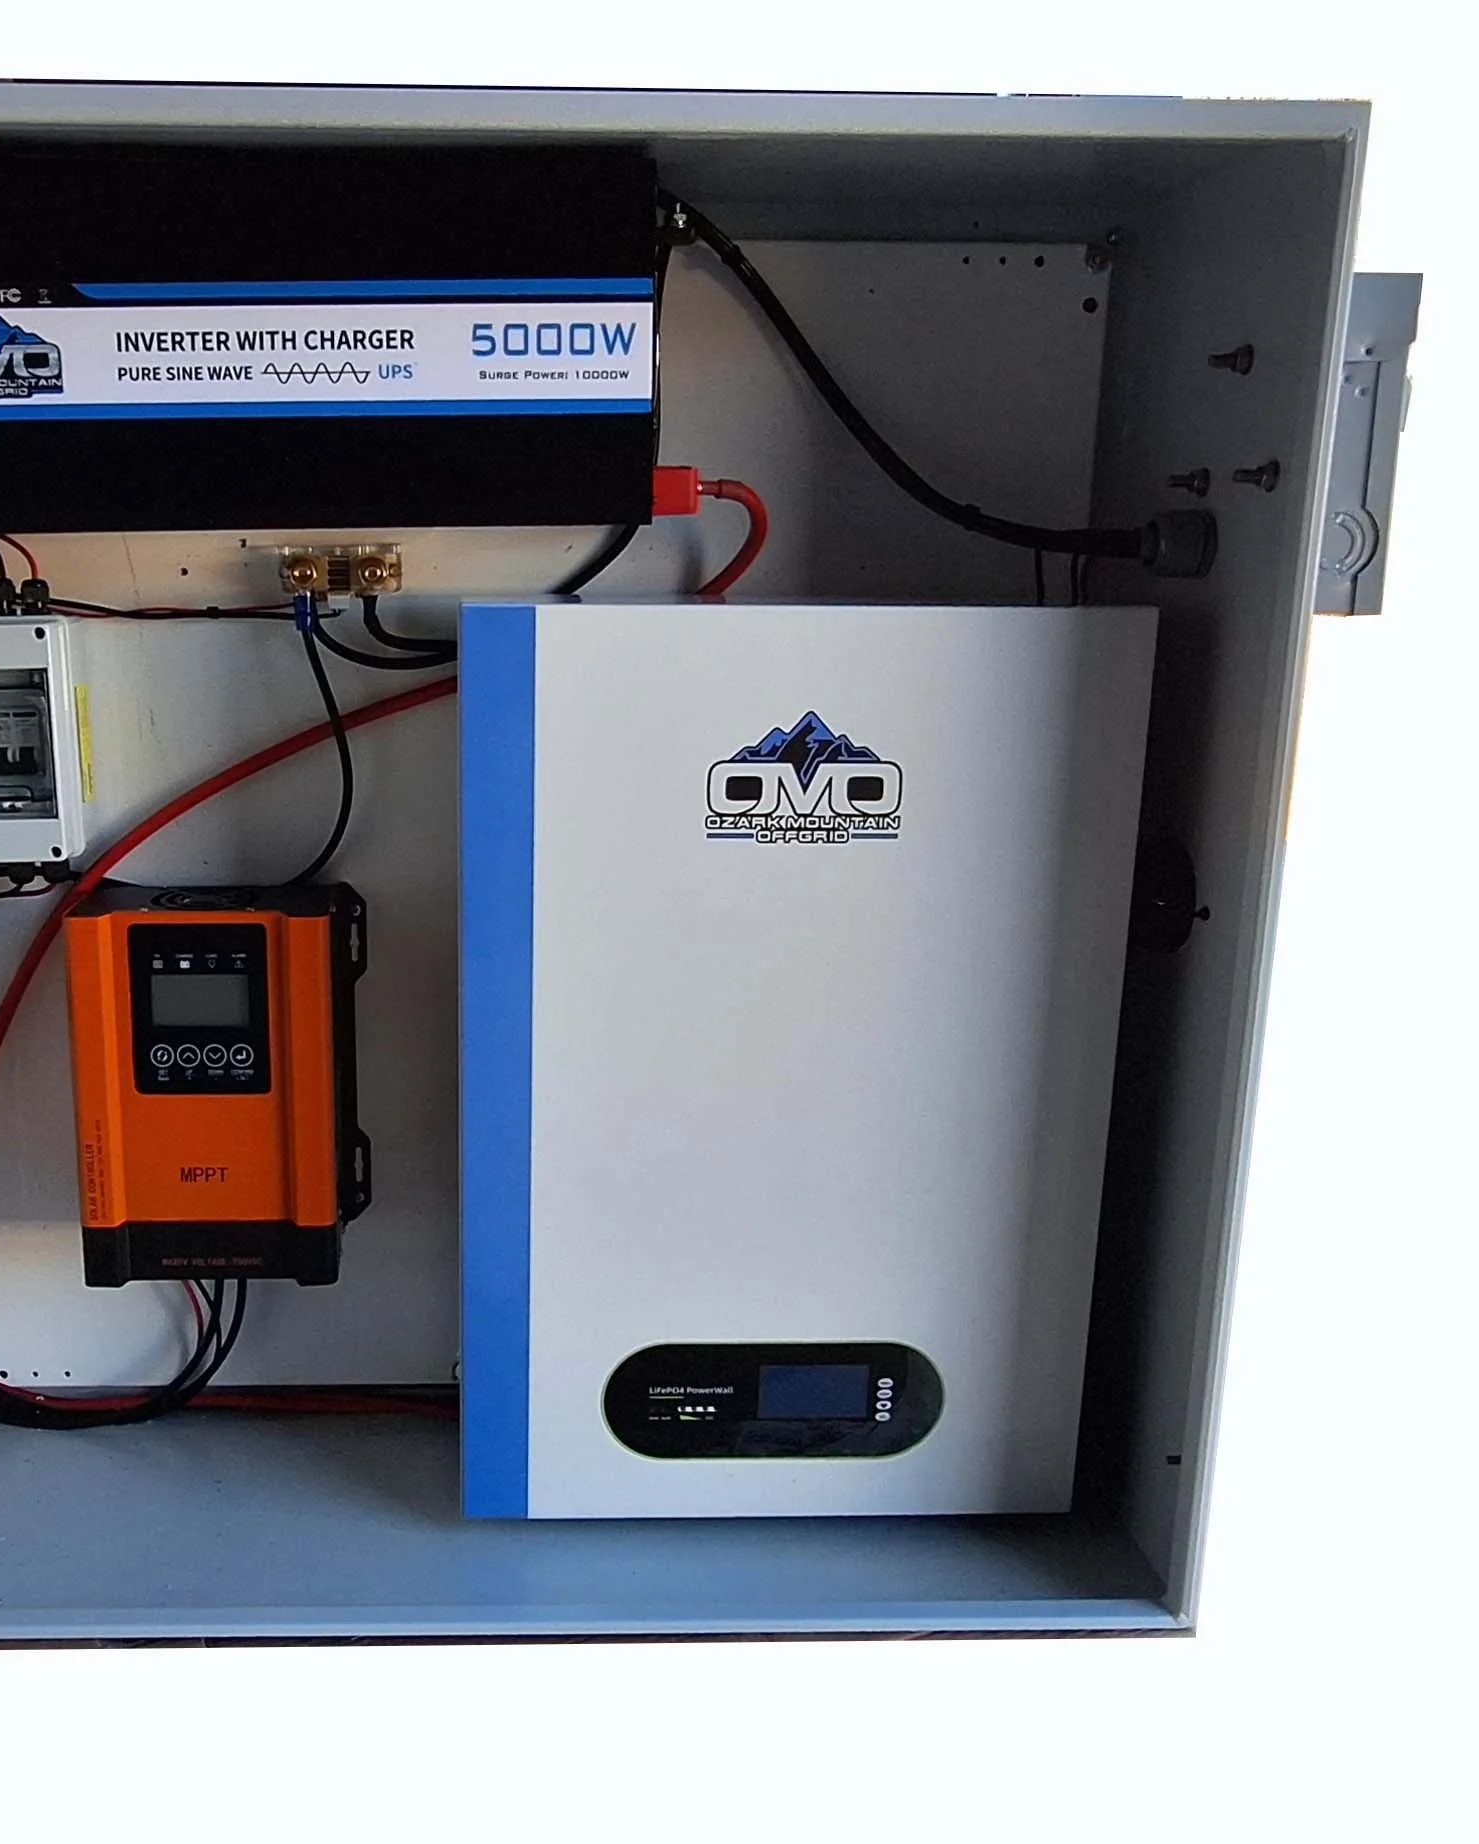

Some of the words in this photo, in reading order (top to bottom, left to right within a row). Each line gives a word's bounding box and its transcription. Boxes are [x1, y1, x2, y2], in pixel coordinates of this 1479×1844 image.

[116, 331, 231, 353] INVERTER
[236, 330, 297, 351] WITH
[304, 329, 415, 351] CHARGER
[471, 322, 637, 357] 5000W
[117, 366, 162, 382] PURE
[166, 366, 204, 381] SINE
[207, 365, 254, 381] WAVE
[378, 363, 414, 380] UPS
[575, 369, 630, 380] 10000W
[705, 815, 784, 830] OZARK
[785, 815, 901, 830] MOUNTAIN
[755, 829, 850, 844] OFFGRID
[180, 1166, 229, 1183] MPPT
[686, 1386, 734, 1395] PowerWall
